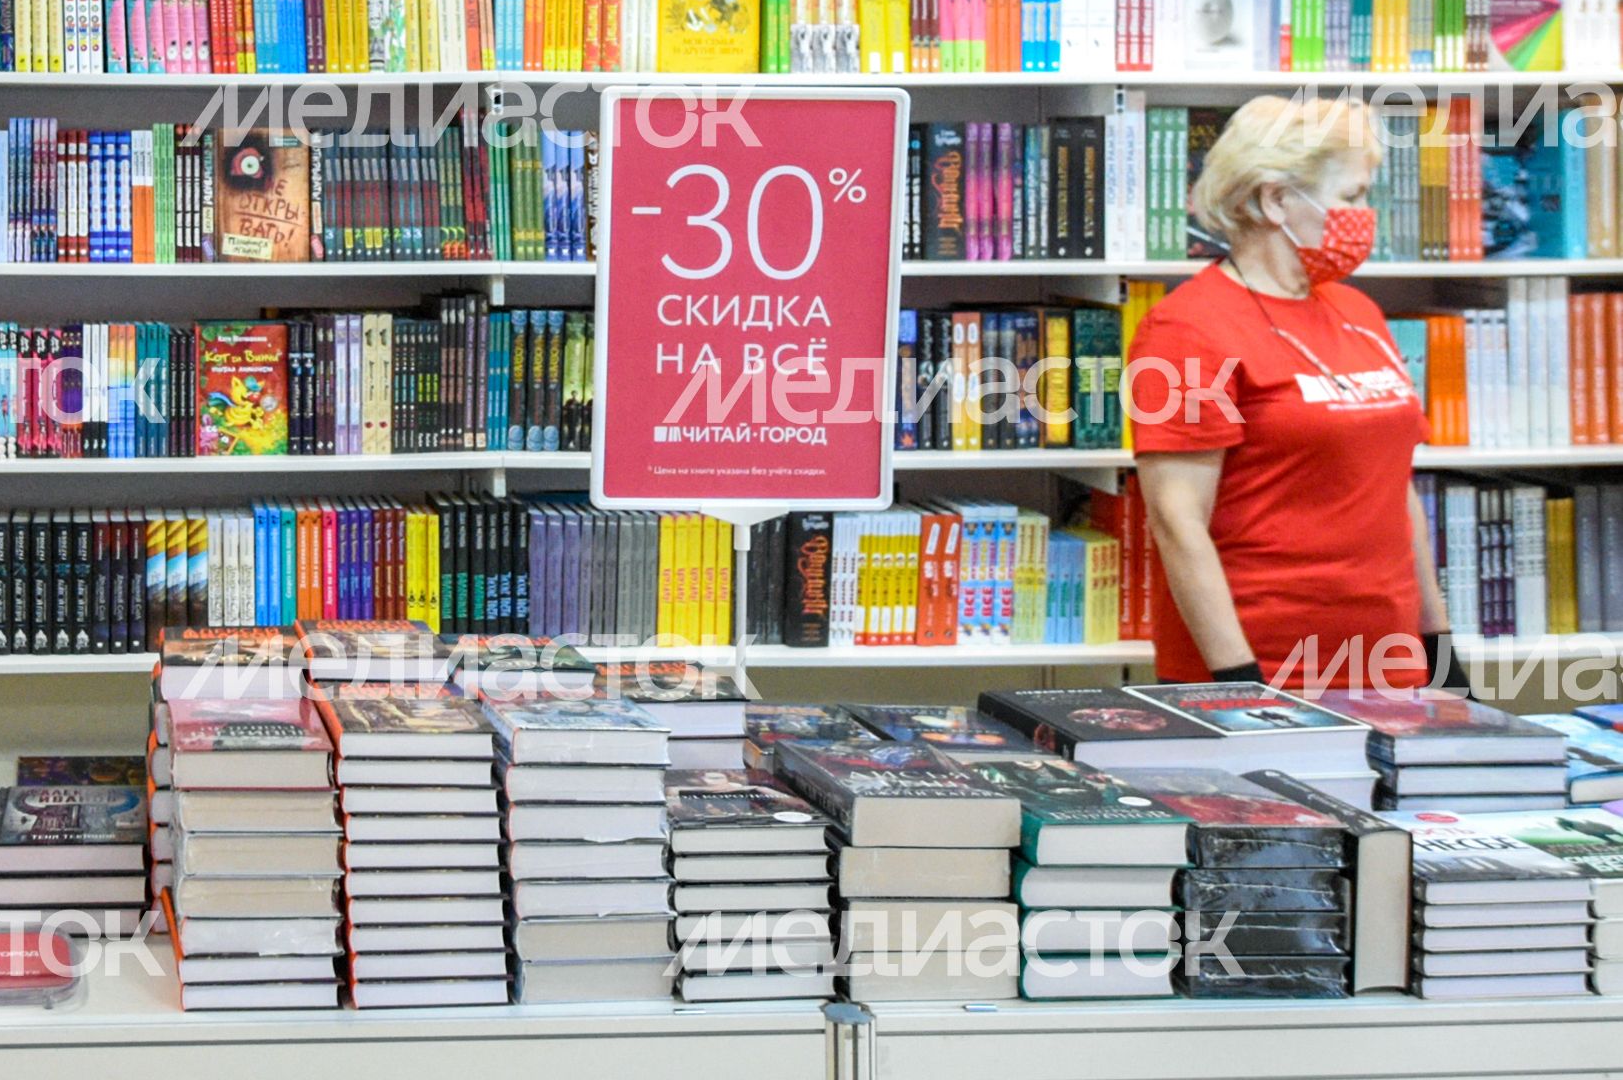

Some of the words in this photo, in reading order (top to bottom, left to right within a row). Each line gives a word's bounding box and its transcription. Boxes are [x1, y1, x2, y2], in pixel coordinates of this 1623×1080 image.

[657, 295, 832, 331] СКИДКА
[656, 343, 721, 375] НА
[743, 337, 828, 375] ВСЁ
